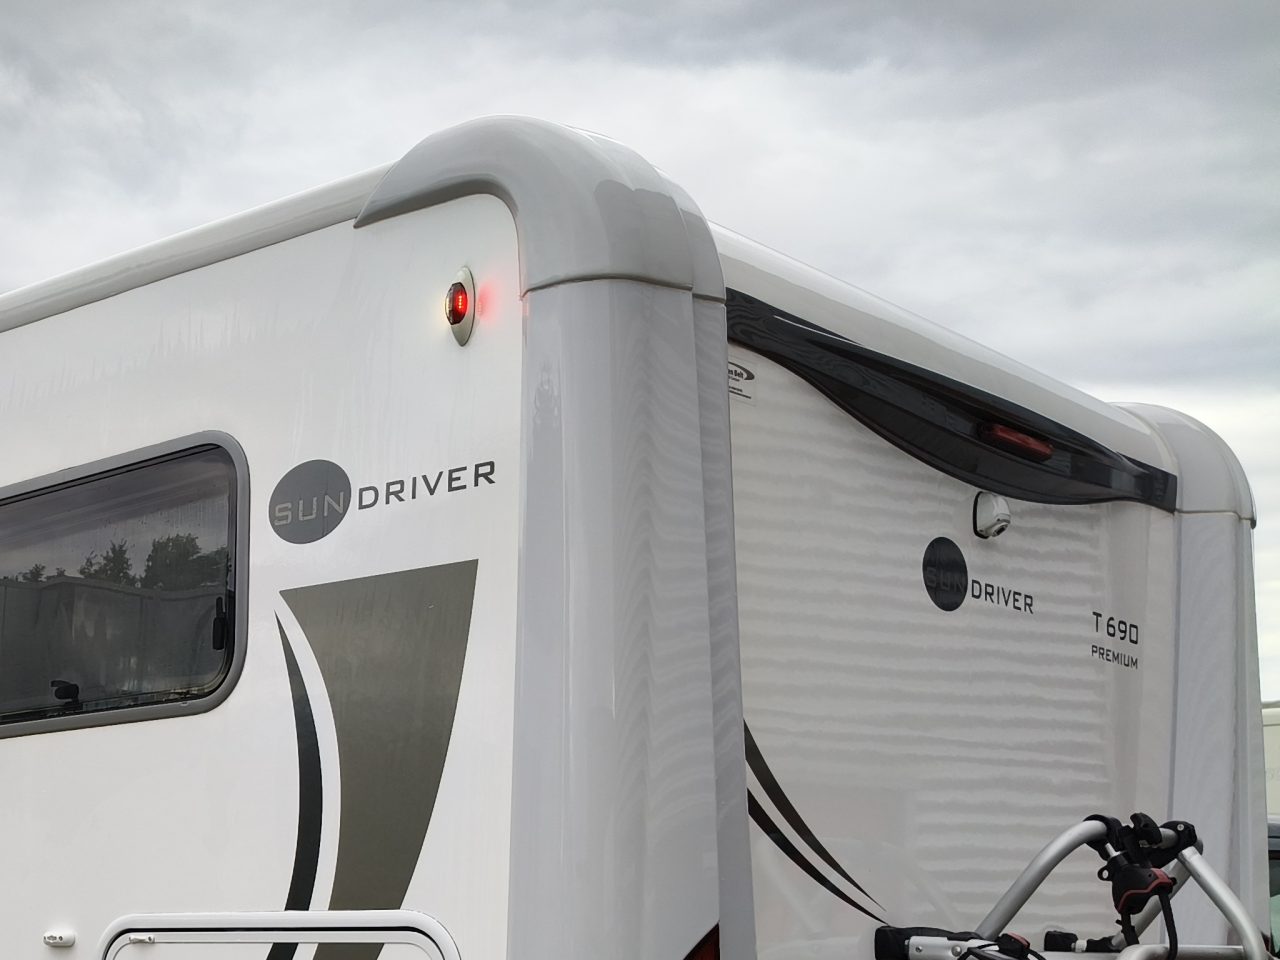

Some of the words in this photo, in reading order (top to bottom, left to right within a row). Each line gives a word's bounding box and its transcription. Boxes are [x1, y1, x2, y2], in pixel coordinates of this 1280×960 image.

[274, 491, 344, 526] SUN
[358, 460, 496, 510] DRIVER
[925, 566, 966, 593] SUN
[971, 579, 1034, 614] DRIVER
[1092, 611, 1103, 633] T
[1106, 616, 1139, 645] 690
[1091, 644, 1138, 669] PREMIUM
